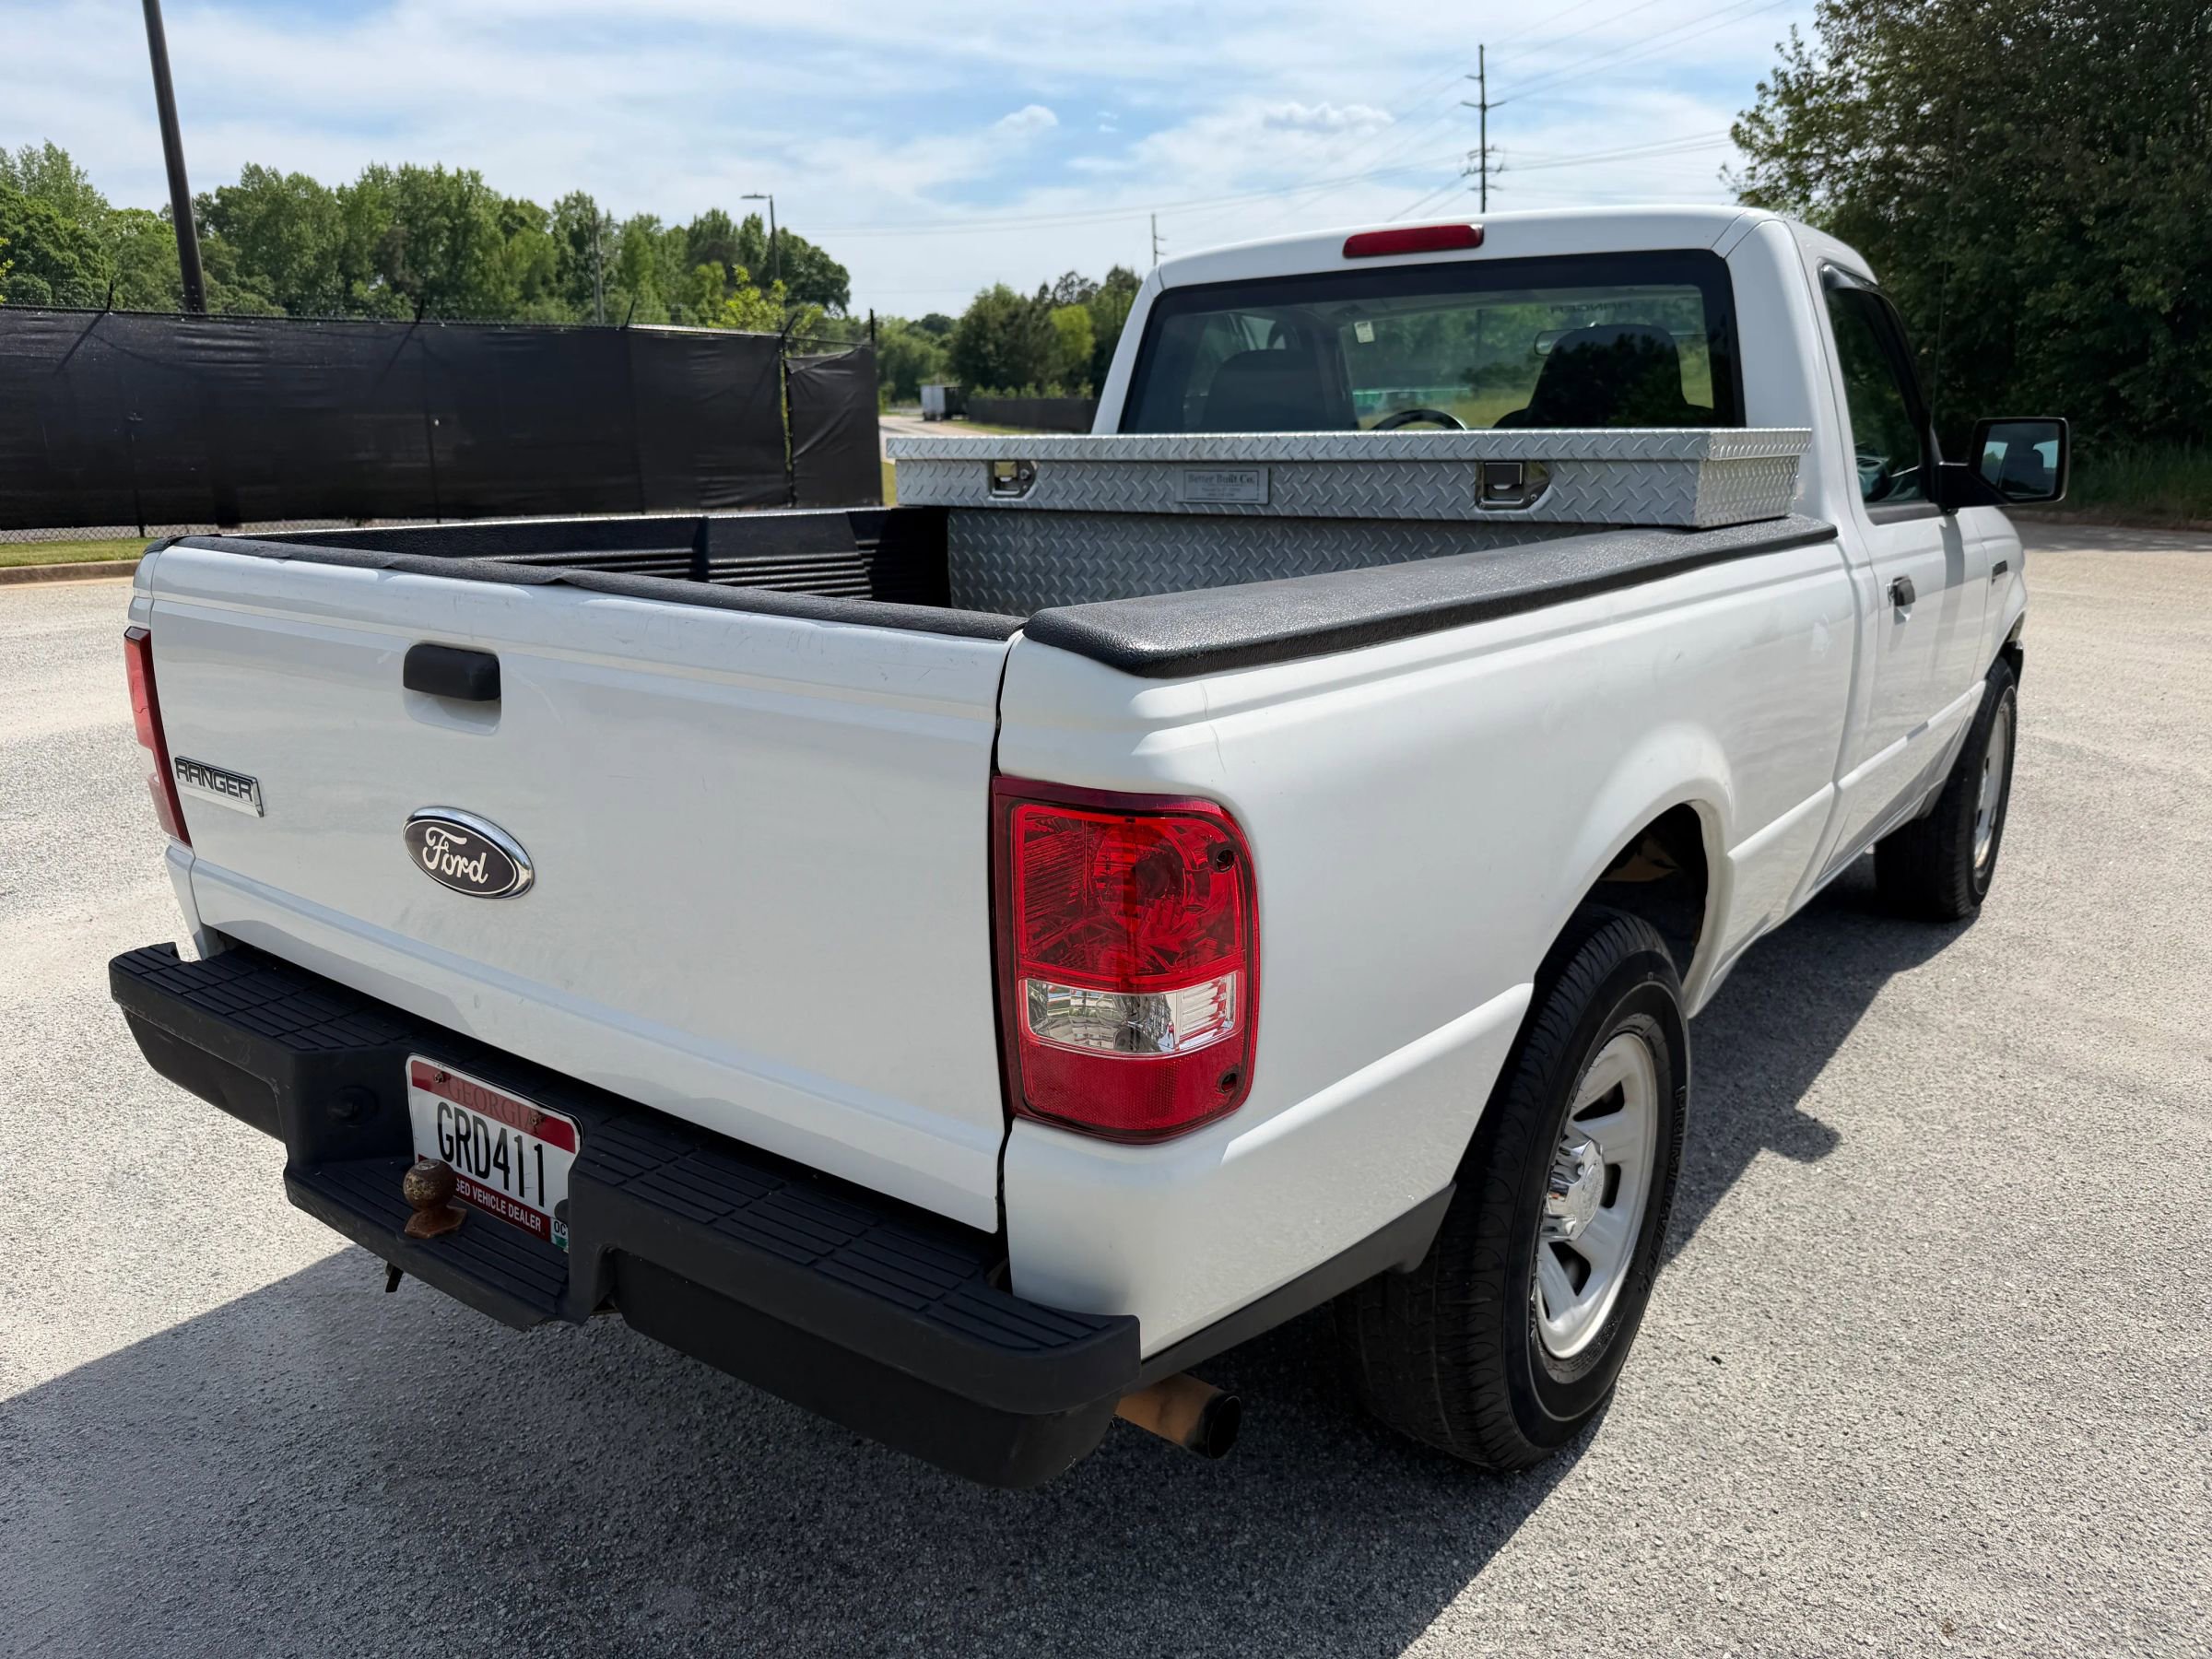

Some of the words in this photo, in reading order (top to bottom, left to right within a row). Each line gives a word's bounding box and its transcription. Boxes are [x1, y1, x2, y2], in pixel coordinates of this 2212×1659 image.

[1217, 474, 1237, 484] Built
[175, 759, 253, 802] RANGER
[422, 826, 488, 884] Ford
[437, 1101, 545, 1207] GRD411
[456, 1178, 471, 1197] SED
[472, 1185, 507, 1216] VEHICLE
[508, 1203, 542, 1232] DEALER
